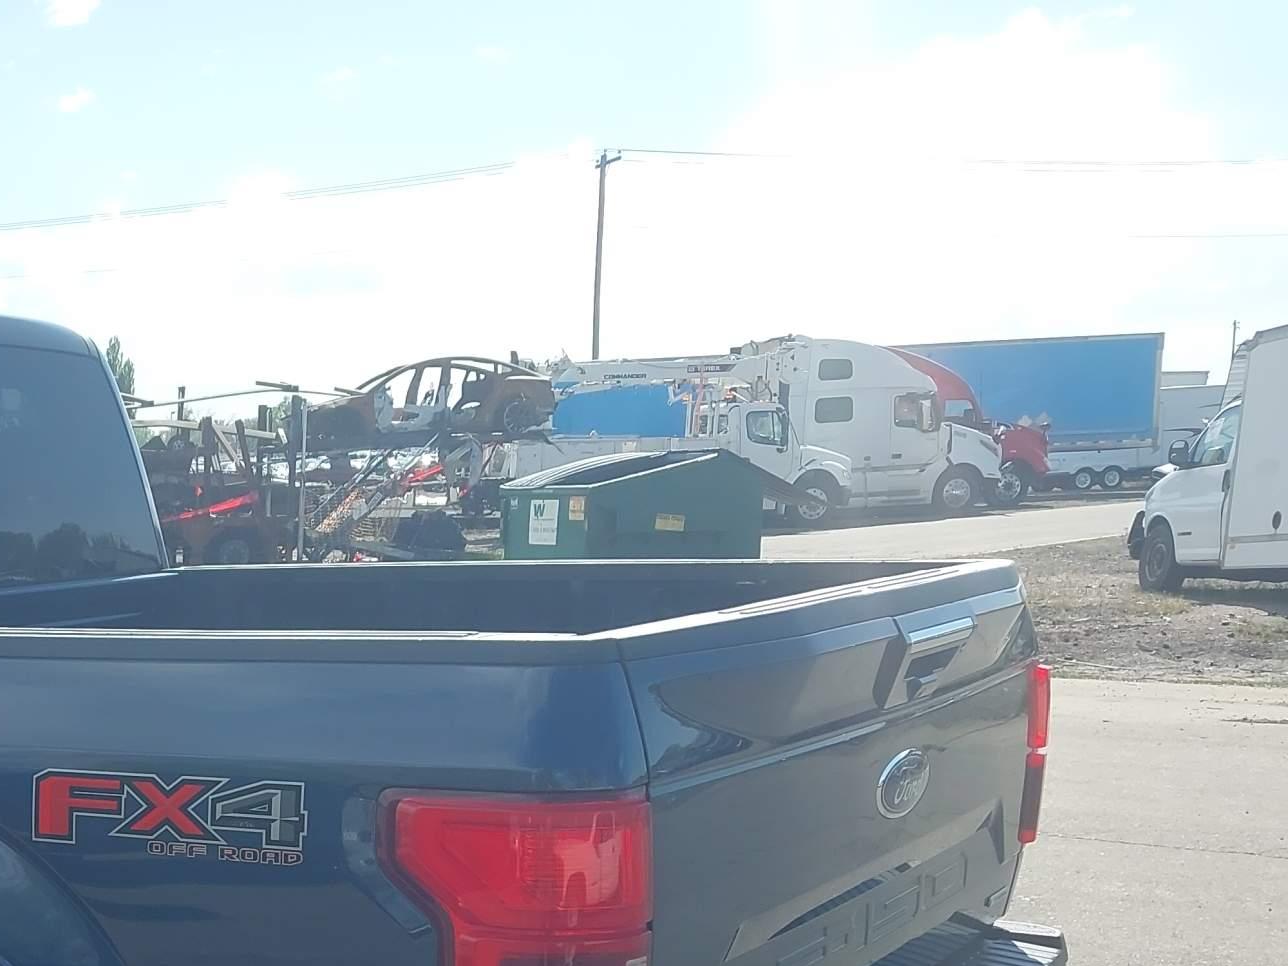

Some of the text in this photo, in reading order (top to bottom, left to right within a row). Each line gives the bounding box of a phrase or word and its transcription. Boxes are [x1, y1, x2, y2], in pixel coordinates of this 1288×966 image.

[32, 768, 308, 850] FX4
[147, 841, 304, 865] OFF ROAD
